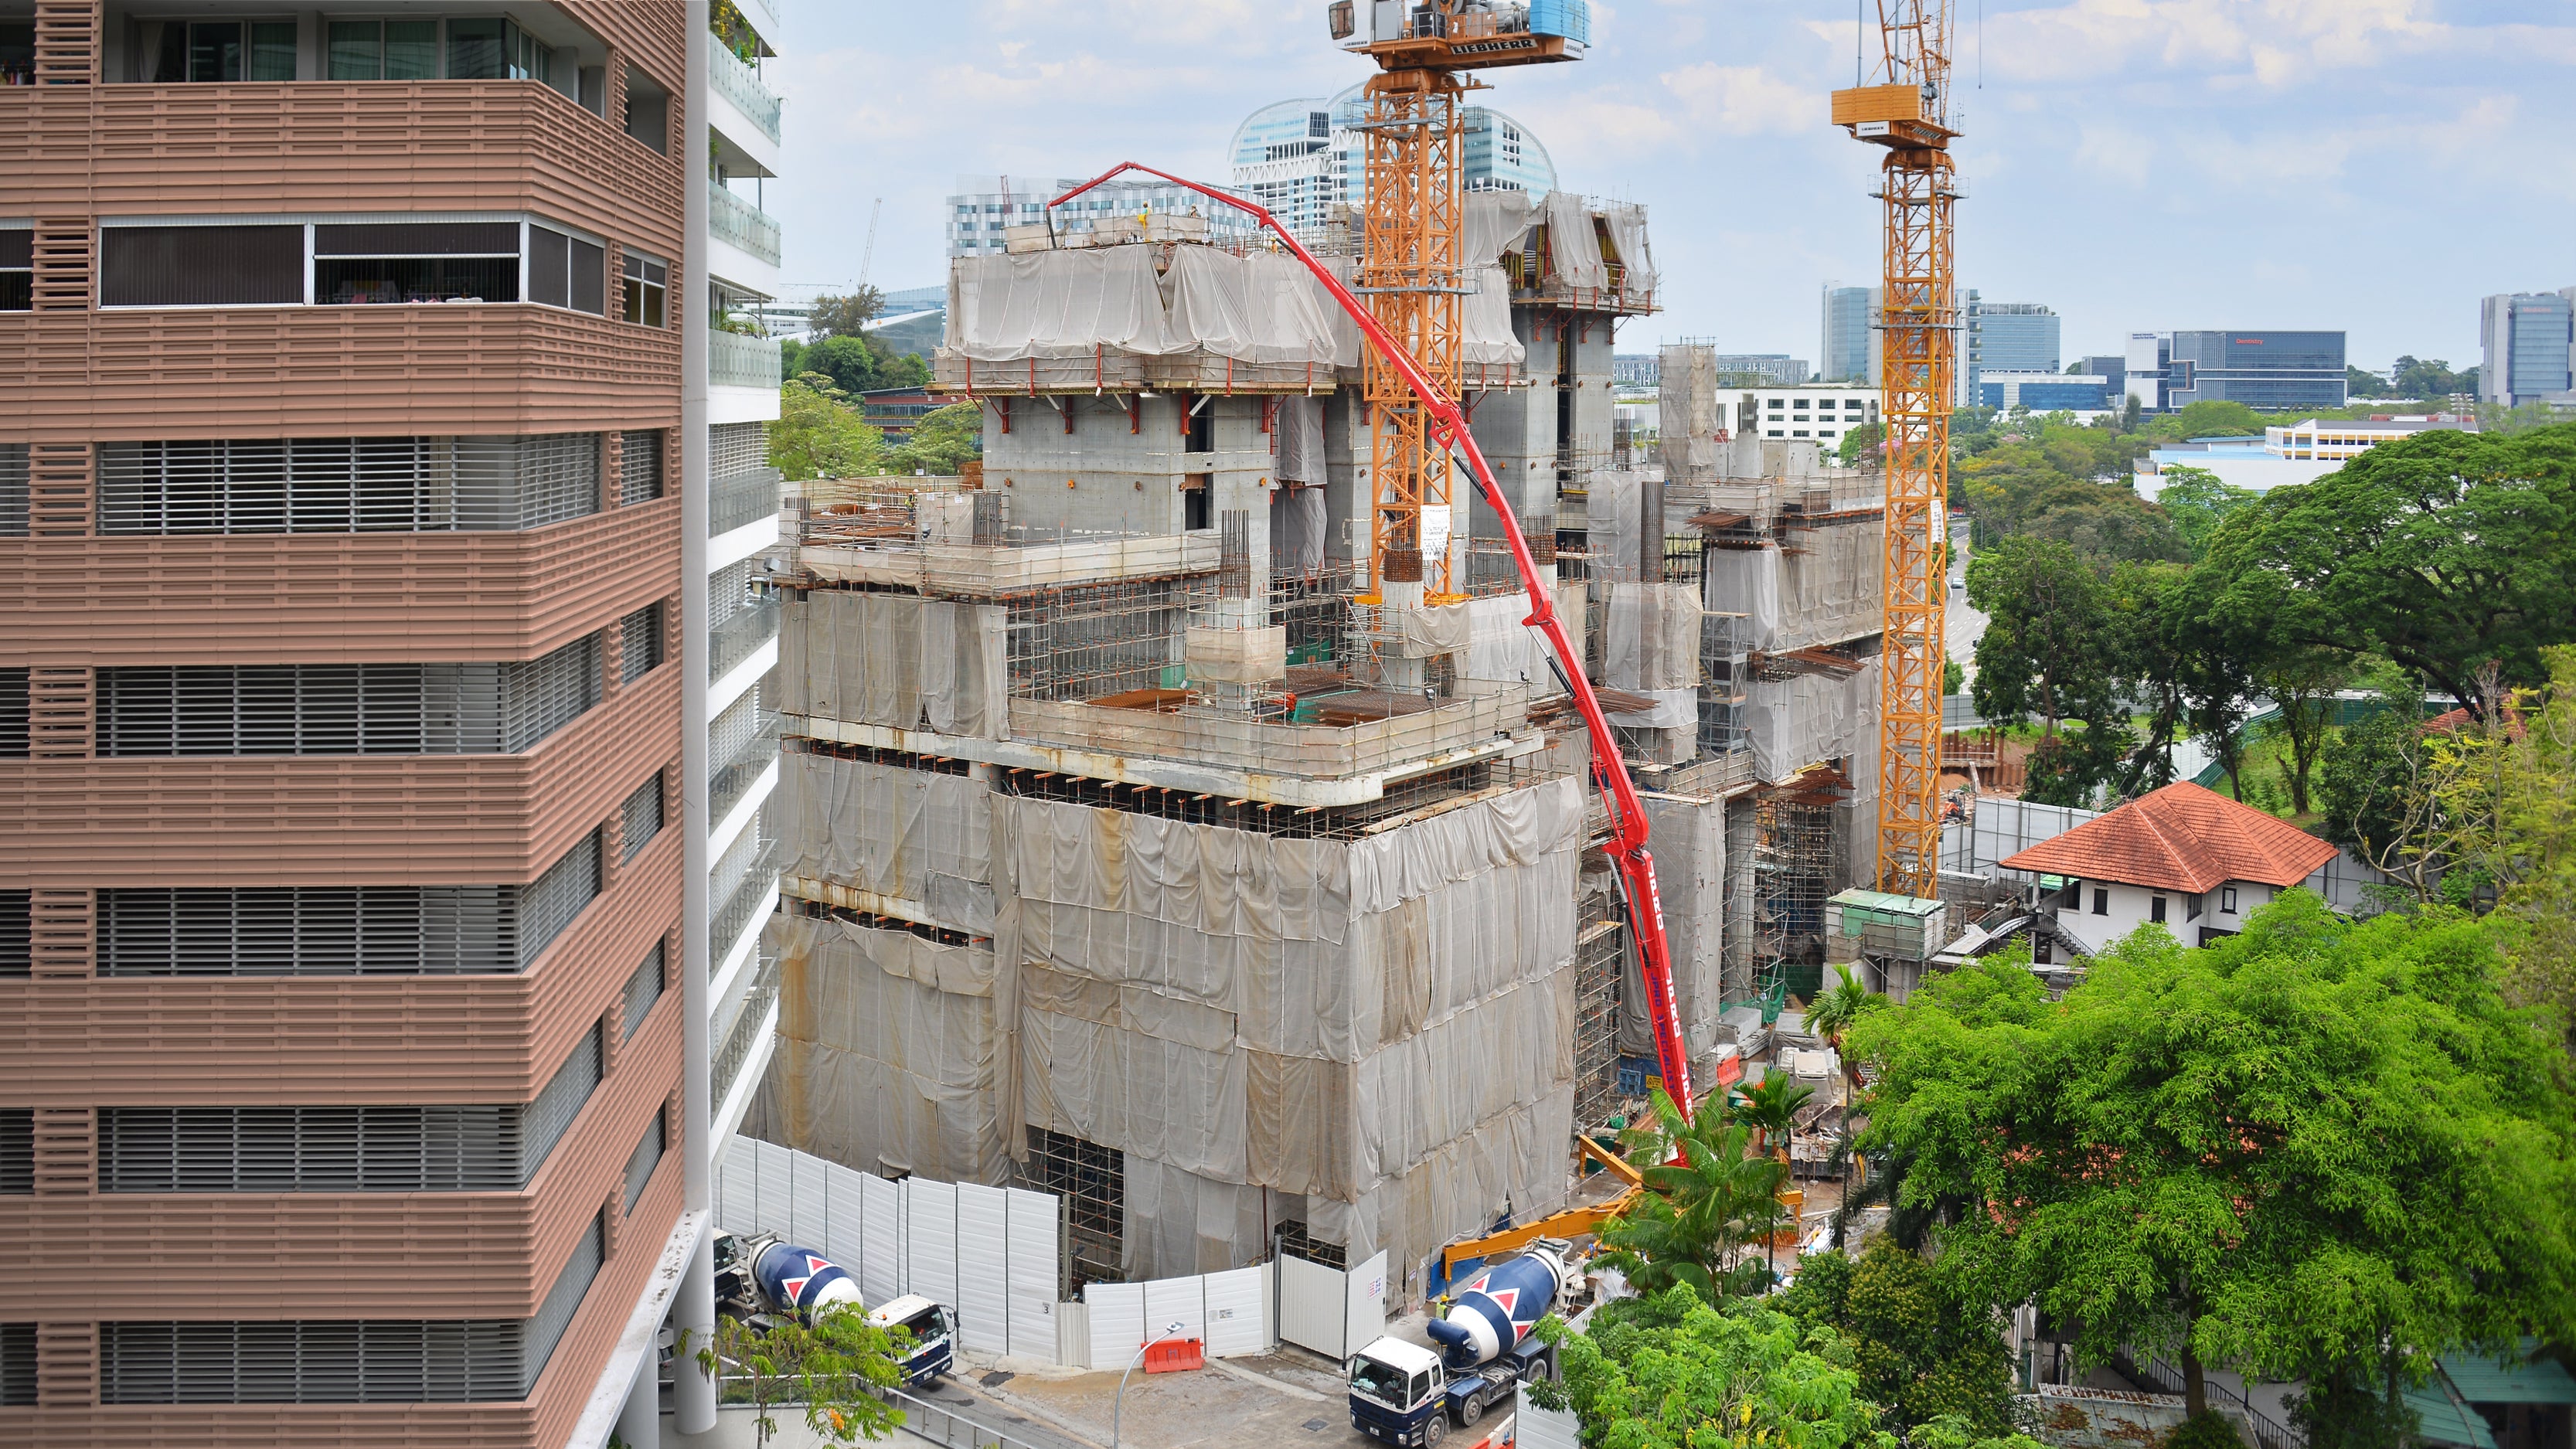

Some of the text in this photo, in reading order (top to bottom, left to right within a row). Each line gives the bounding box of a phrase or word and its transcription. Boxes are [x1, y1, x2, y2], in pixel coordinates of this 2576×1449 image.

[1453, 39, 1533, 54] LIEBHERR
[1648, 860, 1663, 930] JPRO
[1651, 973, 1674, 1089] JPRO SPECIALIST
[1666, 968, 1681, 1038] JPRO
